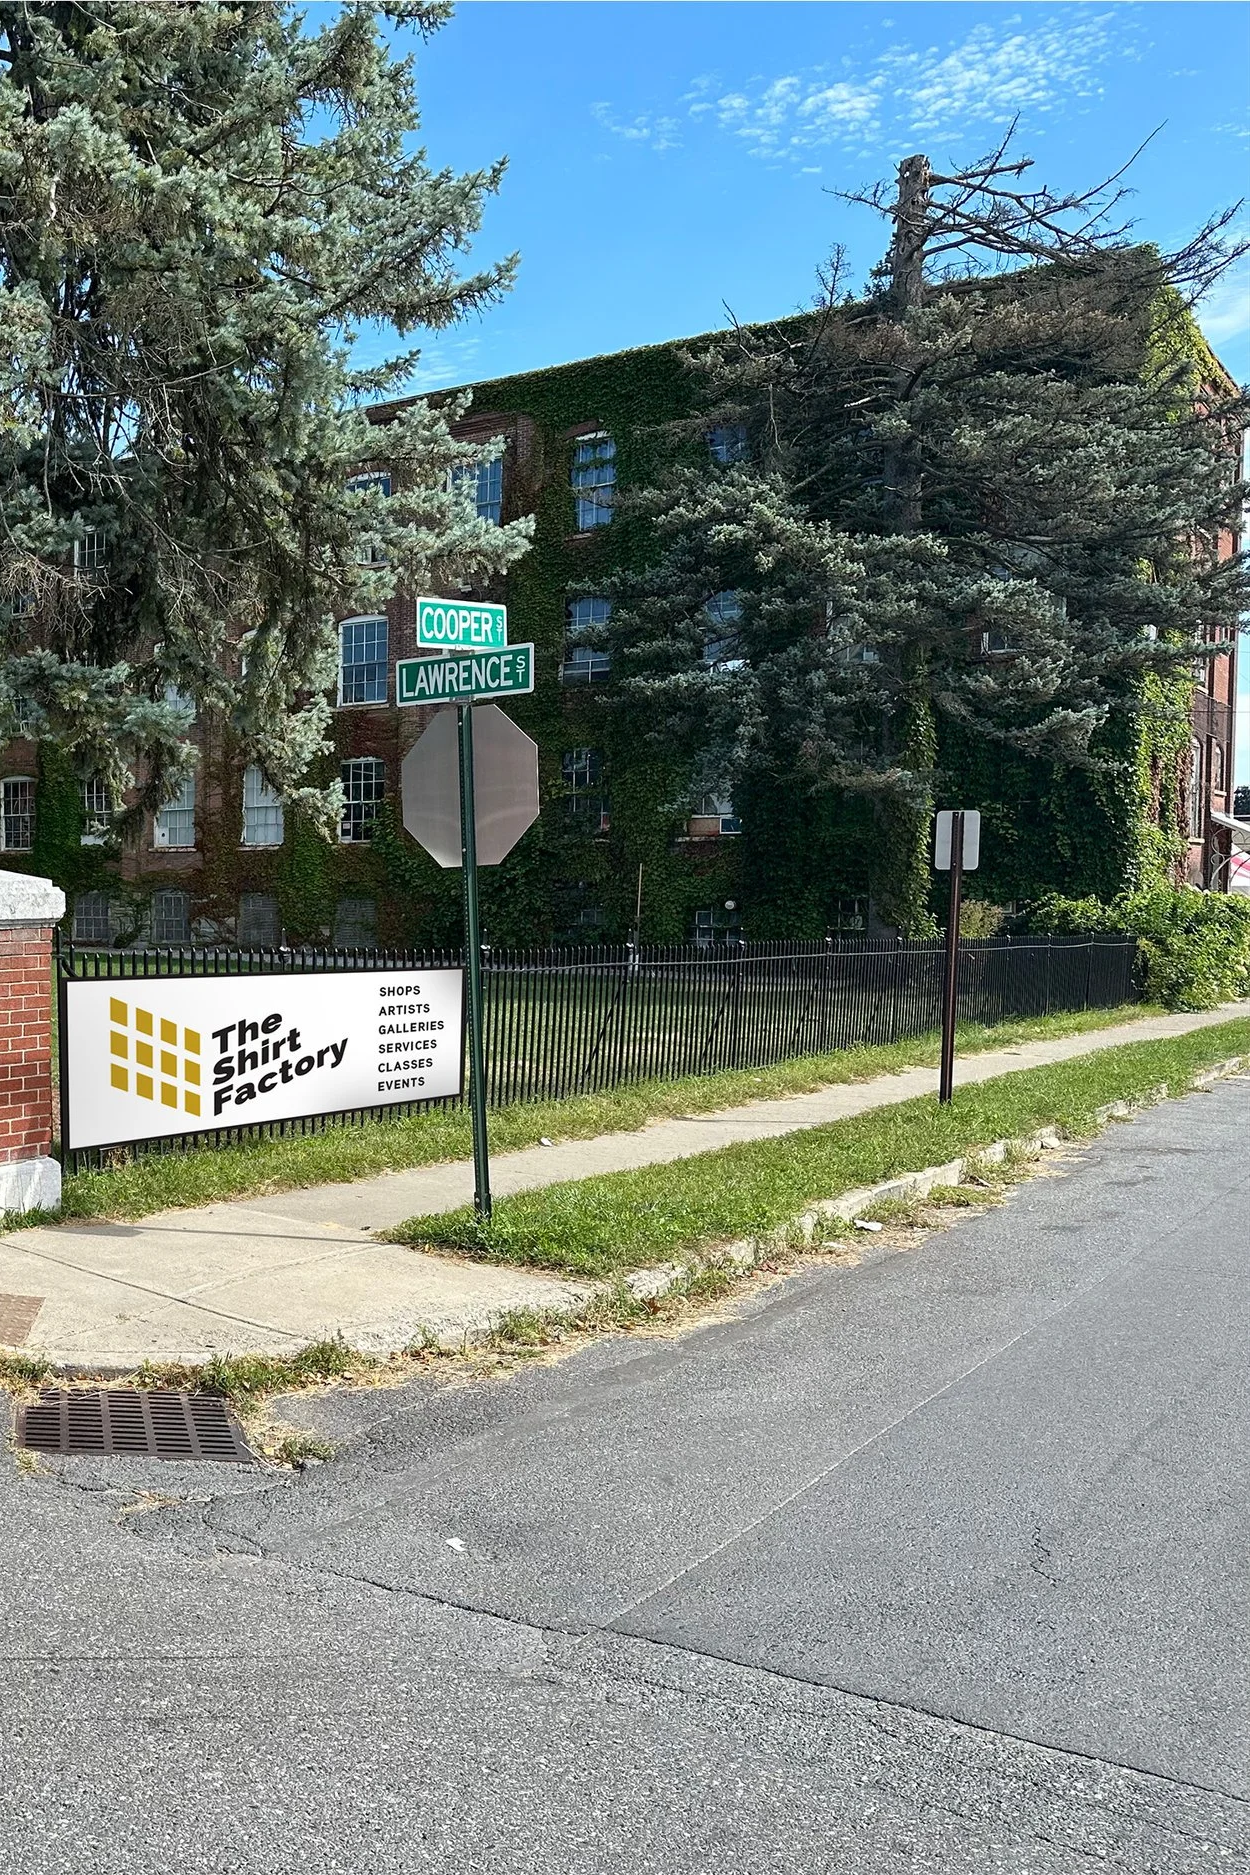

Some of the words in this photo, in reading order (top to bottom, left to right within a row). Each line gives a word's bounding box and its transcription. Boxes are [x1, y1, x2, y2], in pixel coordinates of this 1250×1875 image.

[421, 607, 493, 643] COOPER
[496, 615, 503, 642] ST
[402, 654, 513, 698] LAWRENCE
[515, 655, 526, 683] ST
[379, 986, 421, 997] SHOPS
[378, 1004, 431, 1017] ARTISTS
[211, 1013, 283, 1055] The
[378, 1020, 445, 1035] GALLERIES
[378, 1039, 438, 1054] SERVICES
[211, 1028, 302, 1086] Shirt
[377, 1058, 433, 1073] CLASSES
[213, 1038, 350, 1117] Factory
[377, 1077, 425, 1092] EVENTS
